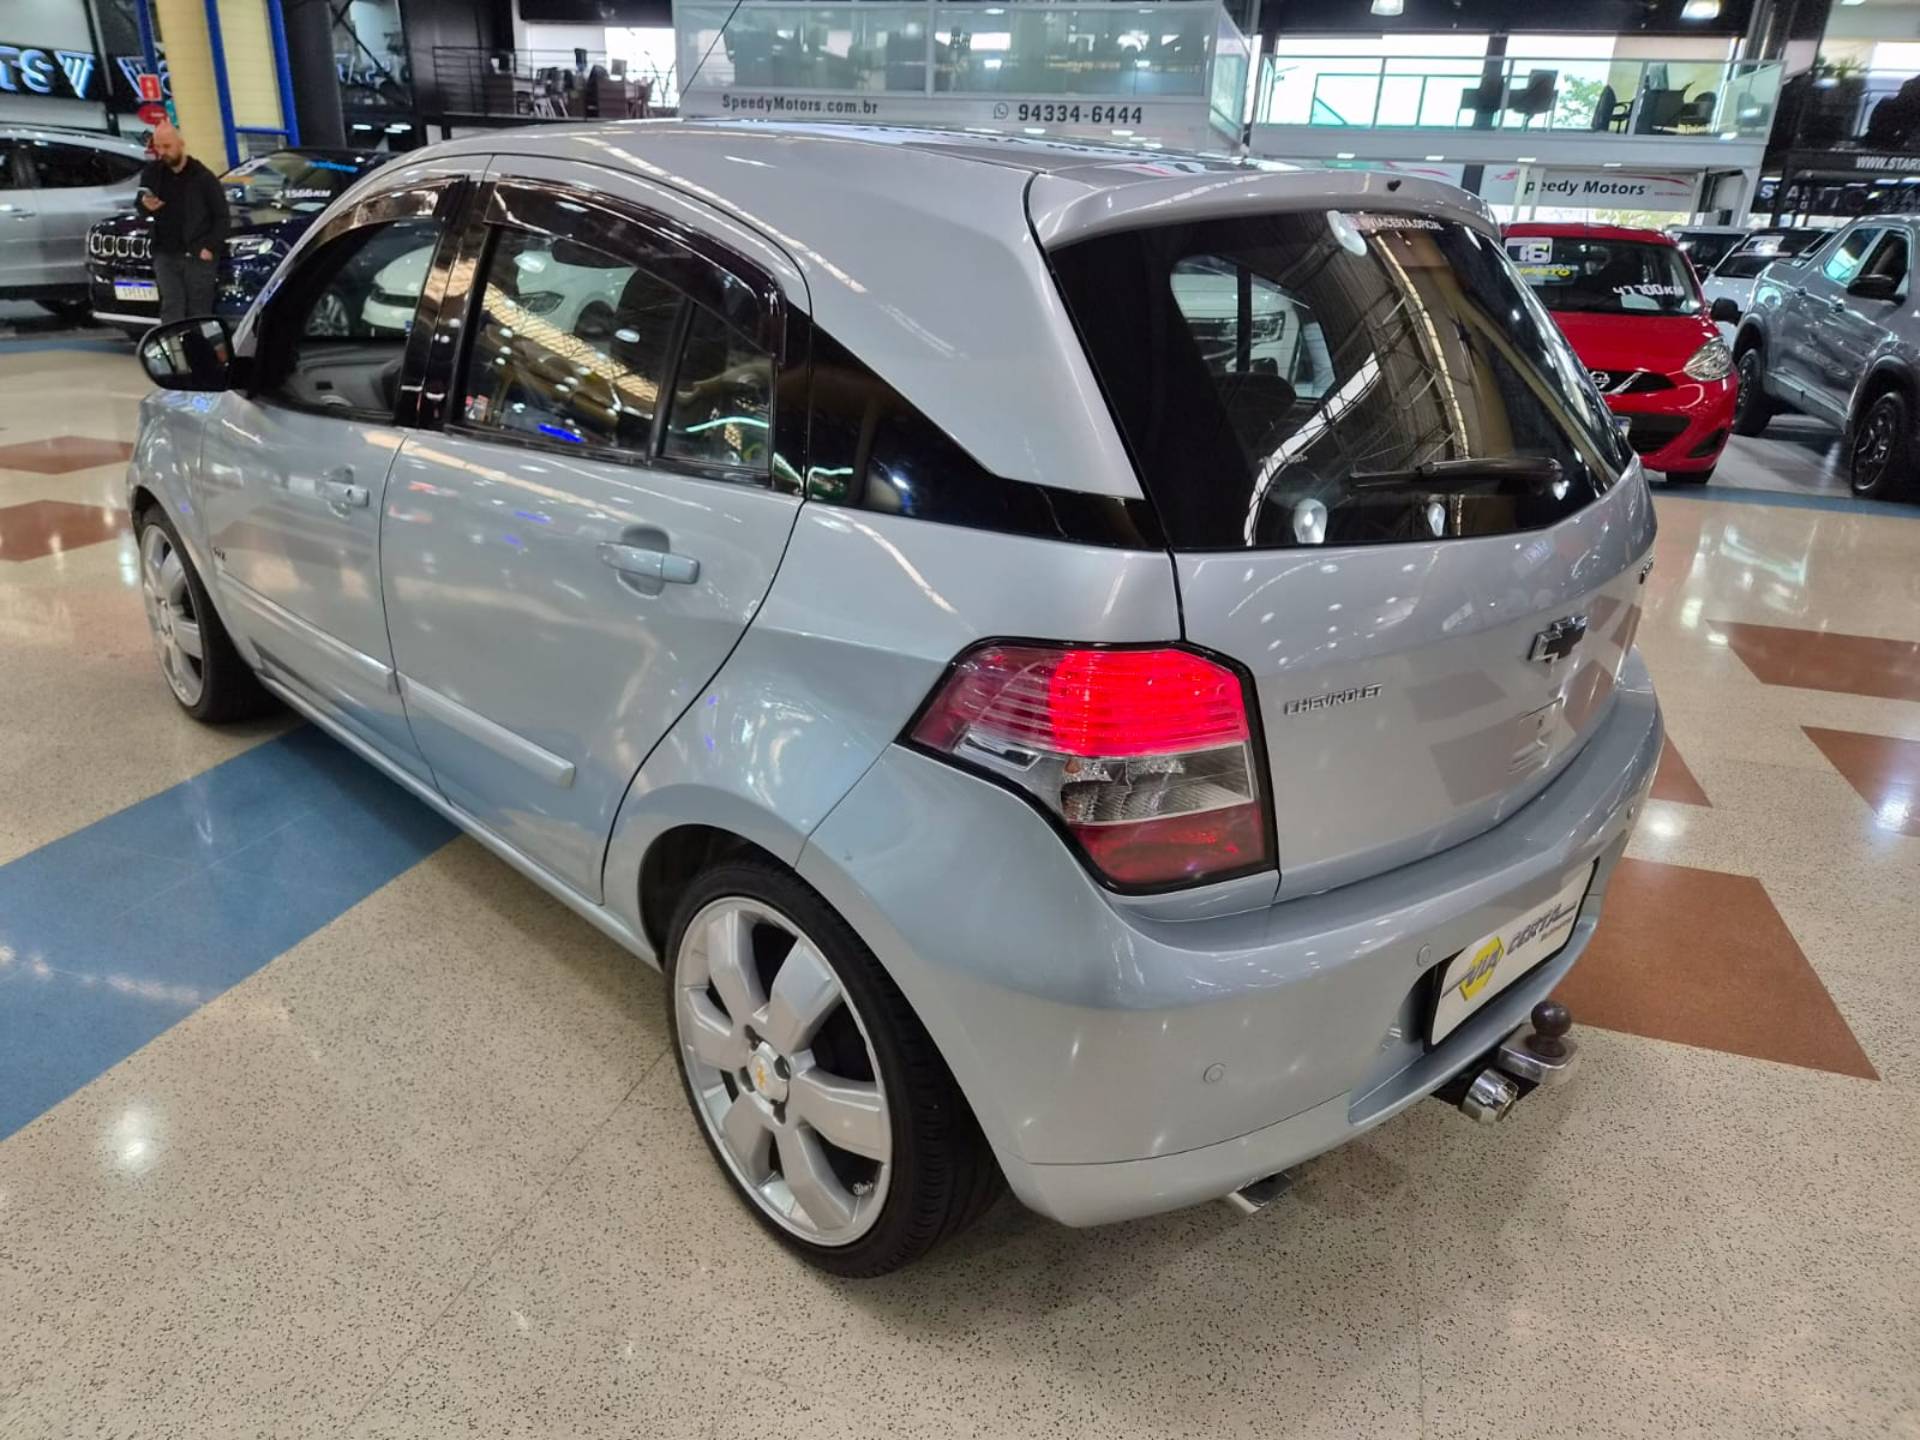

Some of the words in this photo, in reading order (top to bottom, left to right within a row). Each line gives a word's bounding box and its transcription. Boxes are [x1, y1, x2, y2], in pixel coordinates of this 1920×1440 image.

[722, 94, 878, 114] SpeedyMotors.com.br
[1018, 104, 1143, 124] 94334-6444
[1583, 180, 1645, 196] Motors
[1284, 683, 1383, 716] CHEVROLET
